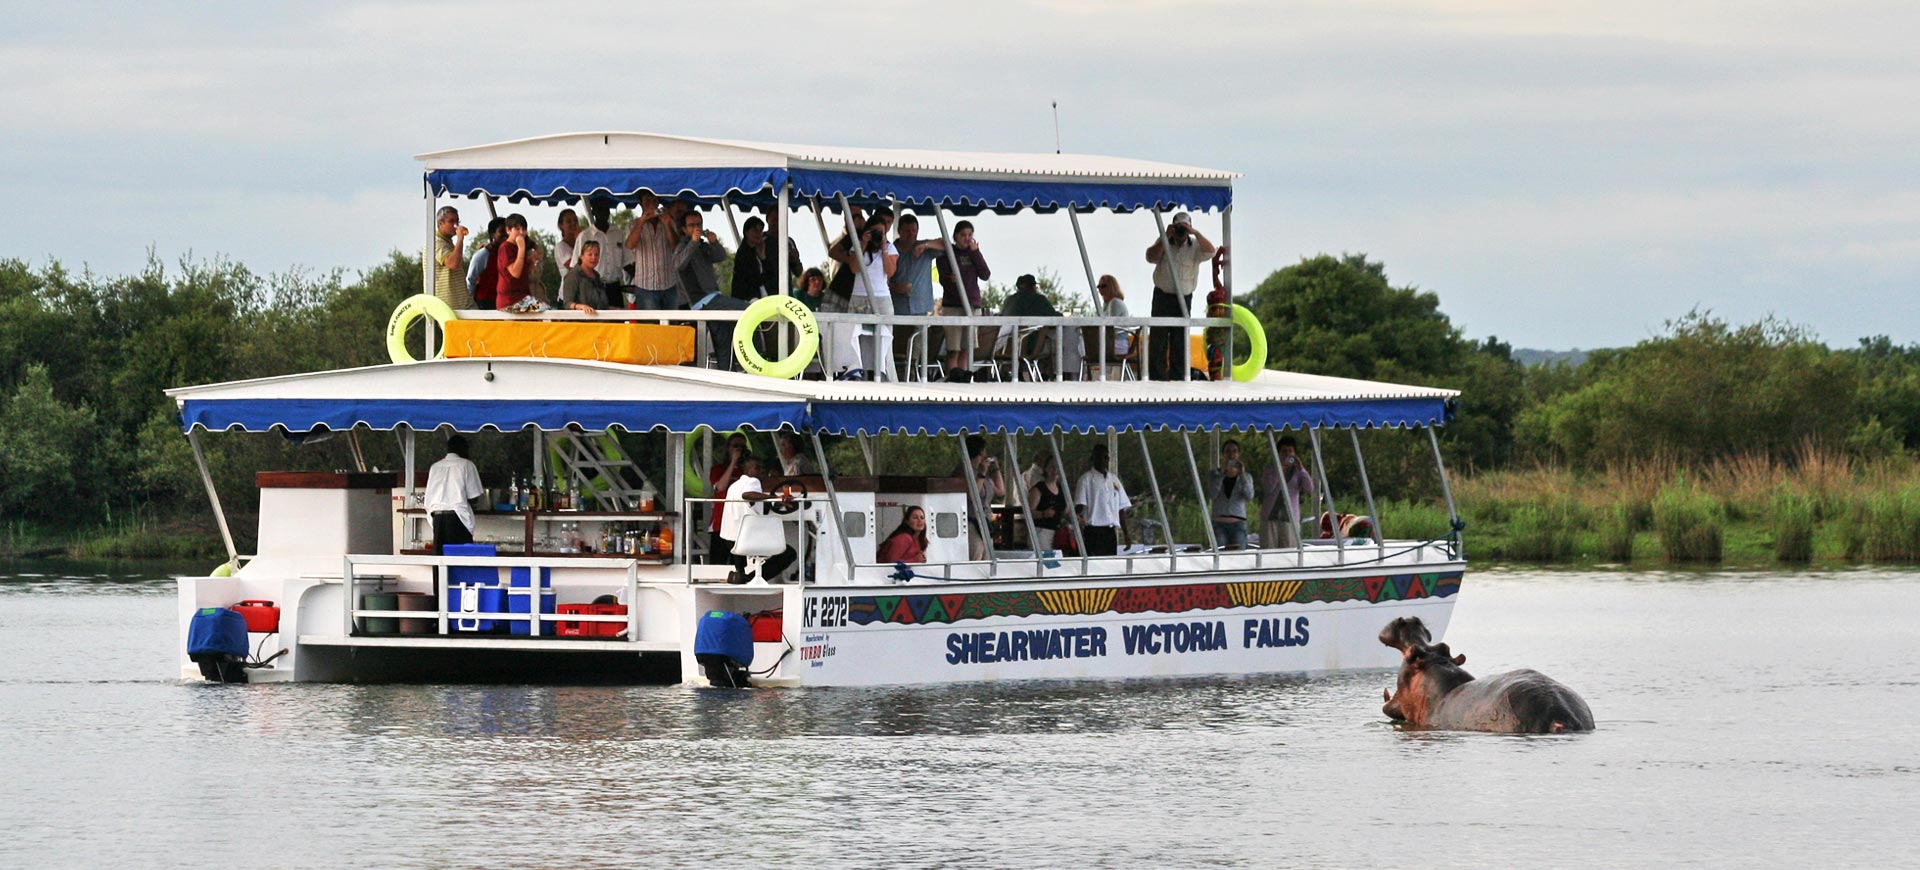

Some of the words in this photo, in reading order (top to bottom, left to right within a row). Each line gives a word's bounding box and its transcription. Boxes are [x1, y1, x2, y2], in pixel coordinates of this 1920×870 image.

[784, 299, 807, 320] 2272
[802, 322, 814, 335] KF
[803, 597, 818, 628] KF
[820, 596, 847, 627] 2272
[945, 625, 1108, 666] SHEARWATER
[1122, 619, 1229, 655] VICTORIA
[1243, 616, 1310, 649] FALLS
[800, 645, 822, 661] TURBO
[822, 643, 836, 658] Glass
